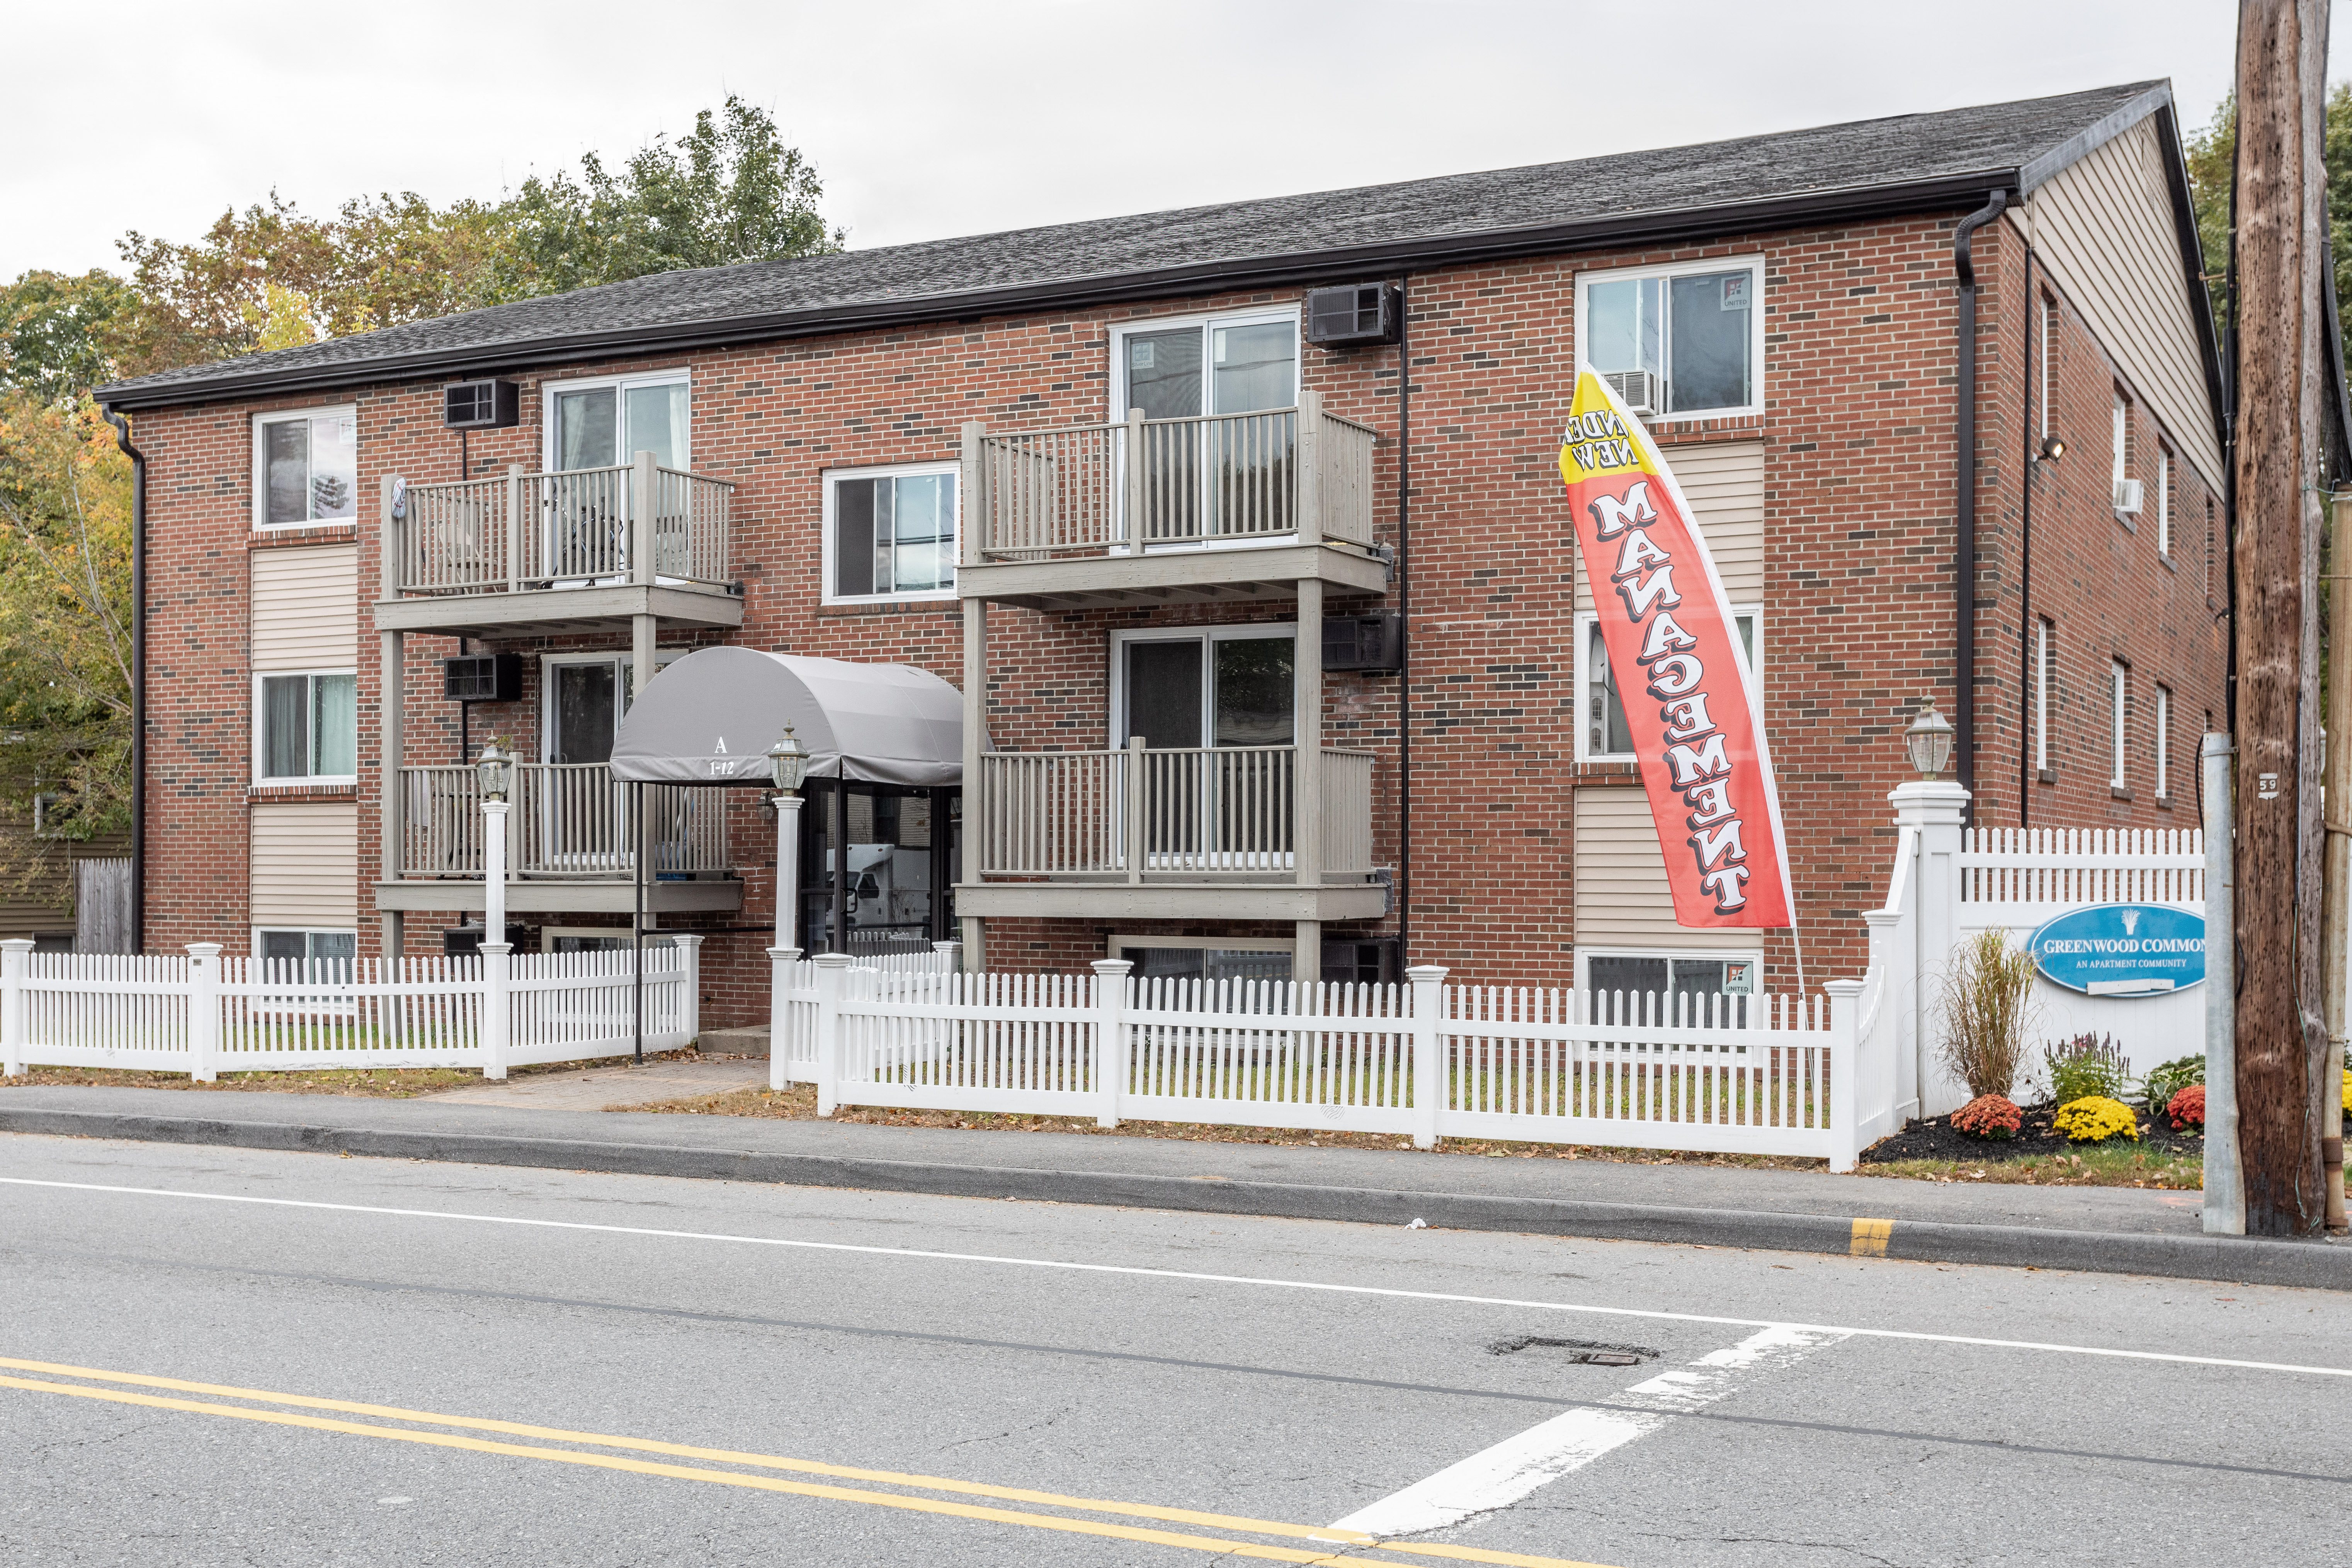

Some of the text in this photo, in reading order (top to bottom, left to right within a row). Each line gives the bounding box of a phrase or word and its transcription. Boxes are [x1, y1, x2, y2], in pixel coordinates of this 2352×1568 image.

[714, 736, 728, 753] A
[709, 761, 734, 775] 1-12
[2259, 779, 2276, 791] 59
[2044, 939, 2139, 953] GREENWOOD
[2076, 959, 2187, 968] AN APARTMENT COMMUNITY
